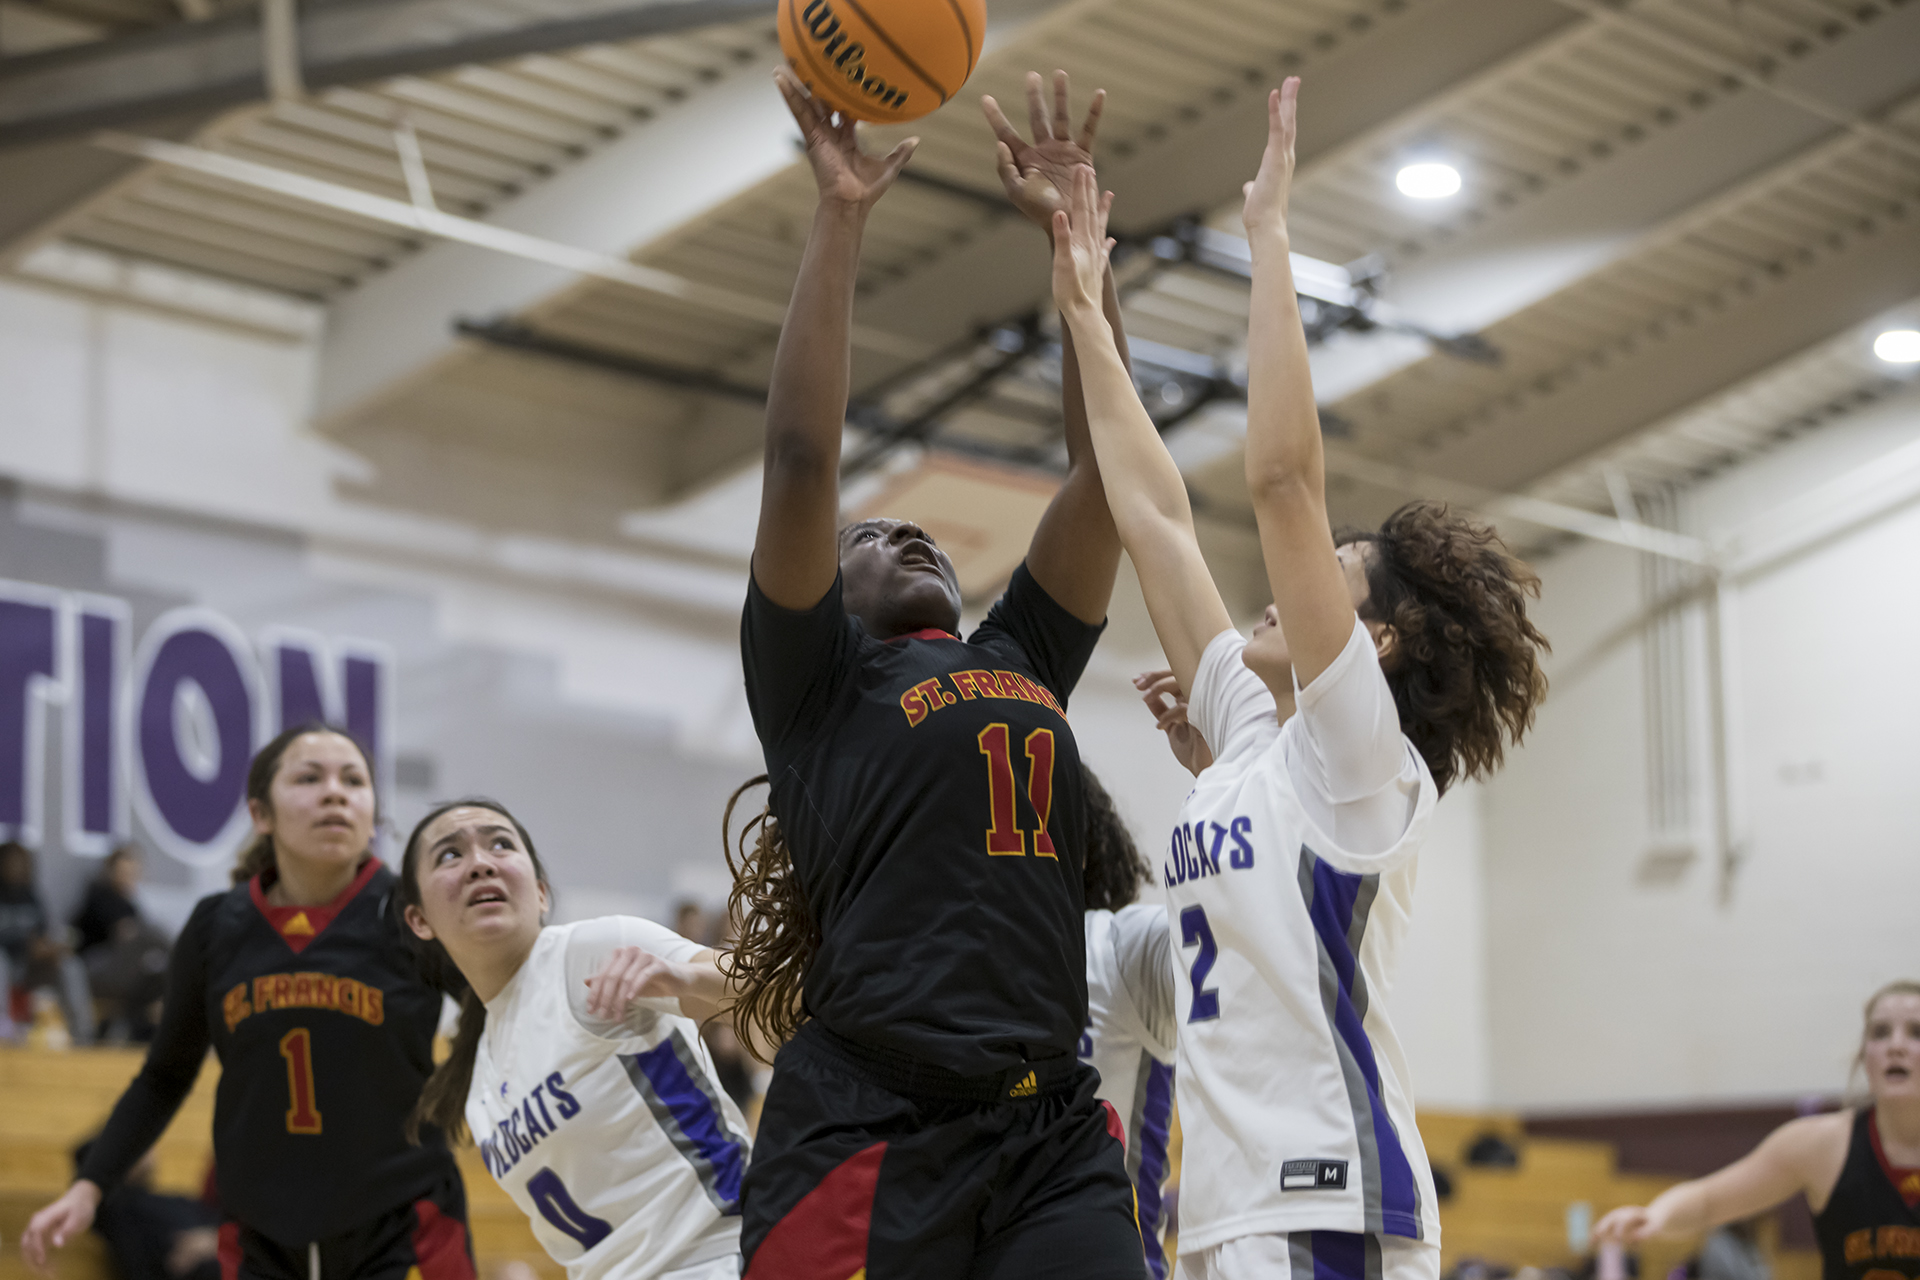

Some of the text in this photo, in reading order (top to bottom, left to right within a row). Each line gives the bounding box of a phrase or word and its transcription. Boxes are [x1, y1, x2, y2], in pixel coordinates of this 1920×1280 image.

[802, 0, 909, 109] Wilson
[900, 676, 957, 728] ST.
[977, 722, 1059, 862] 11
[1164, 815, 1255, 889] LDCATS
[253, 971, 385, 1026] FRANCIS
[1179, 903, 1221, 1025] 2
[279, 1027, 323, 1135] 1
[526, 1166, 614, 1252] 0
[1324, 1166, 1338, 1182] M
